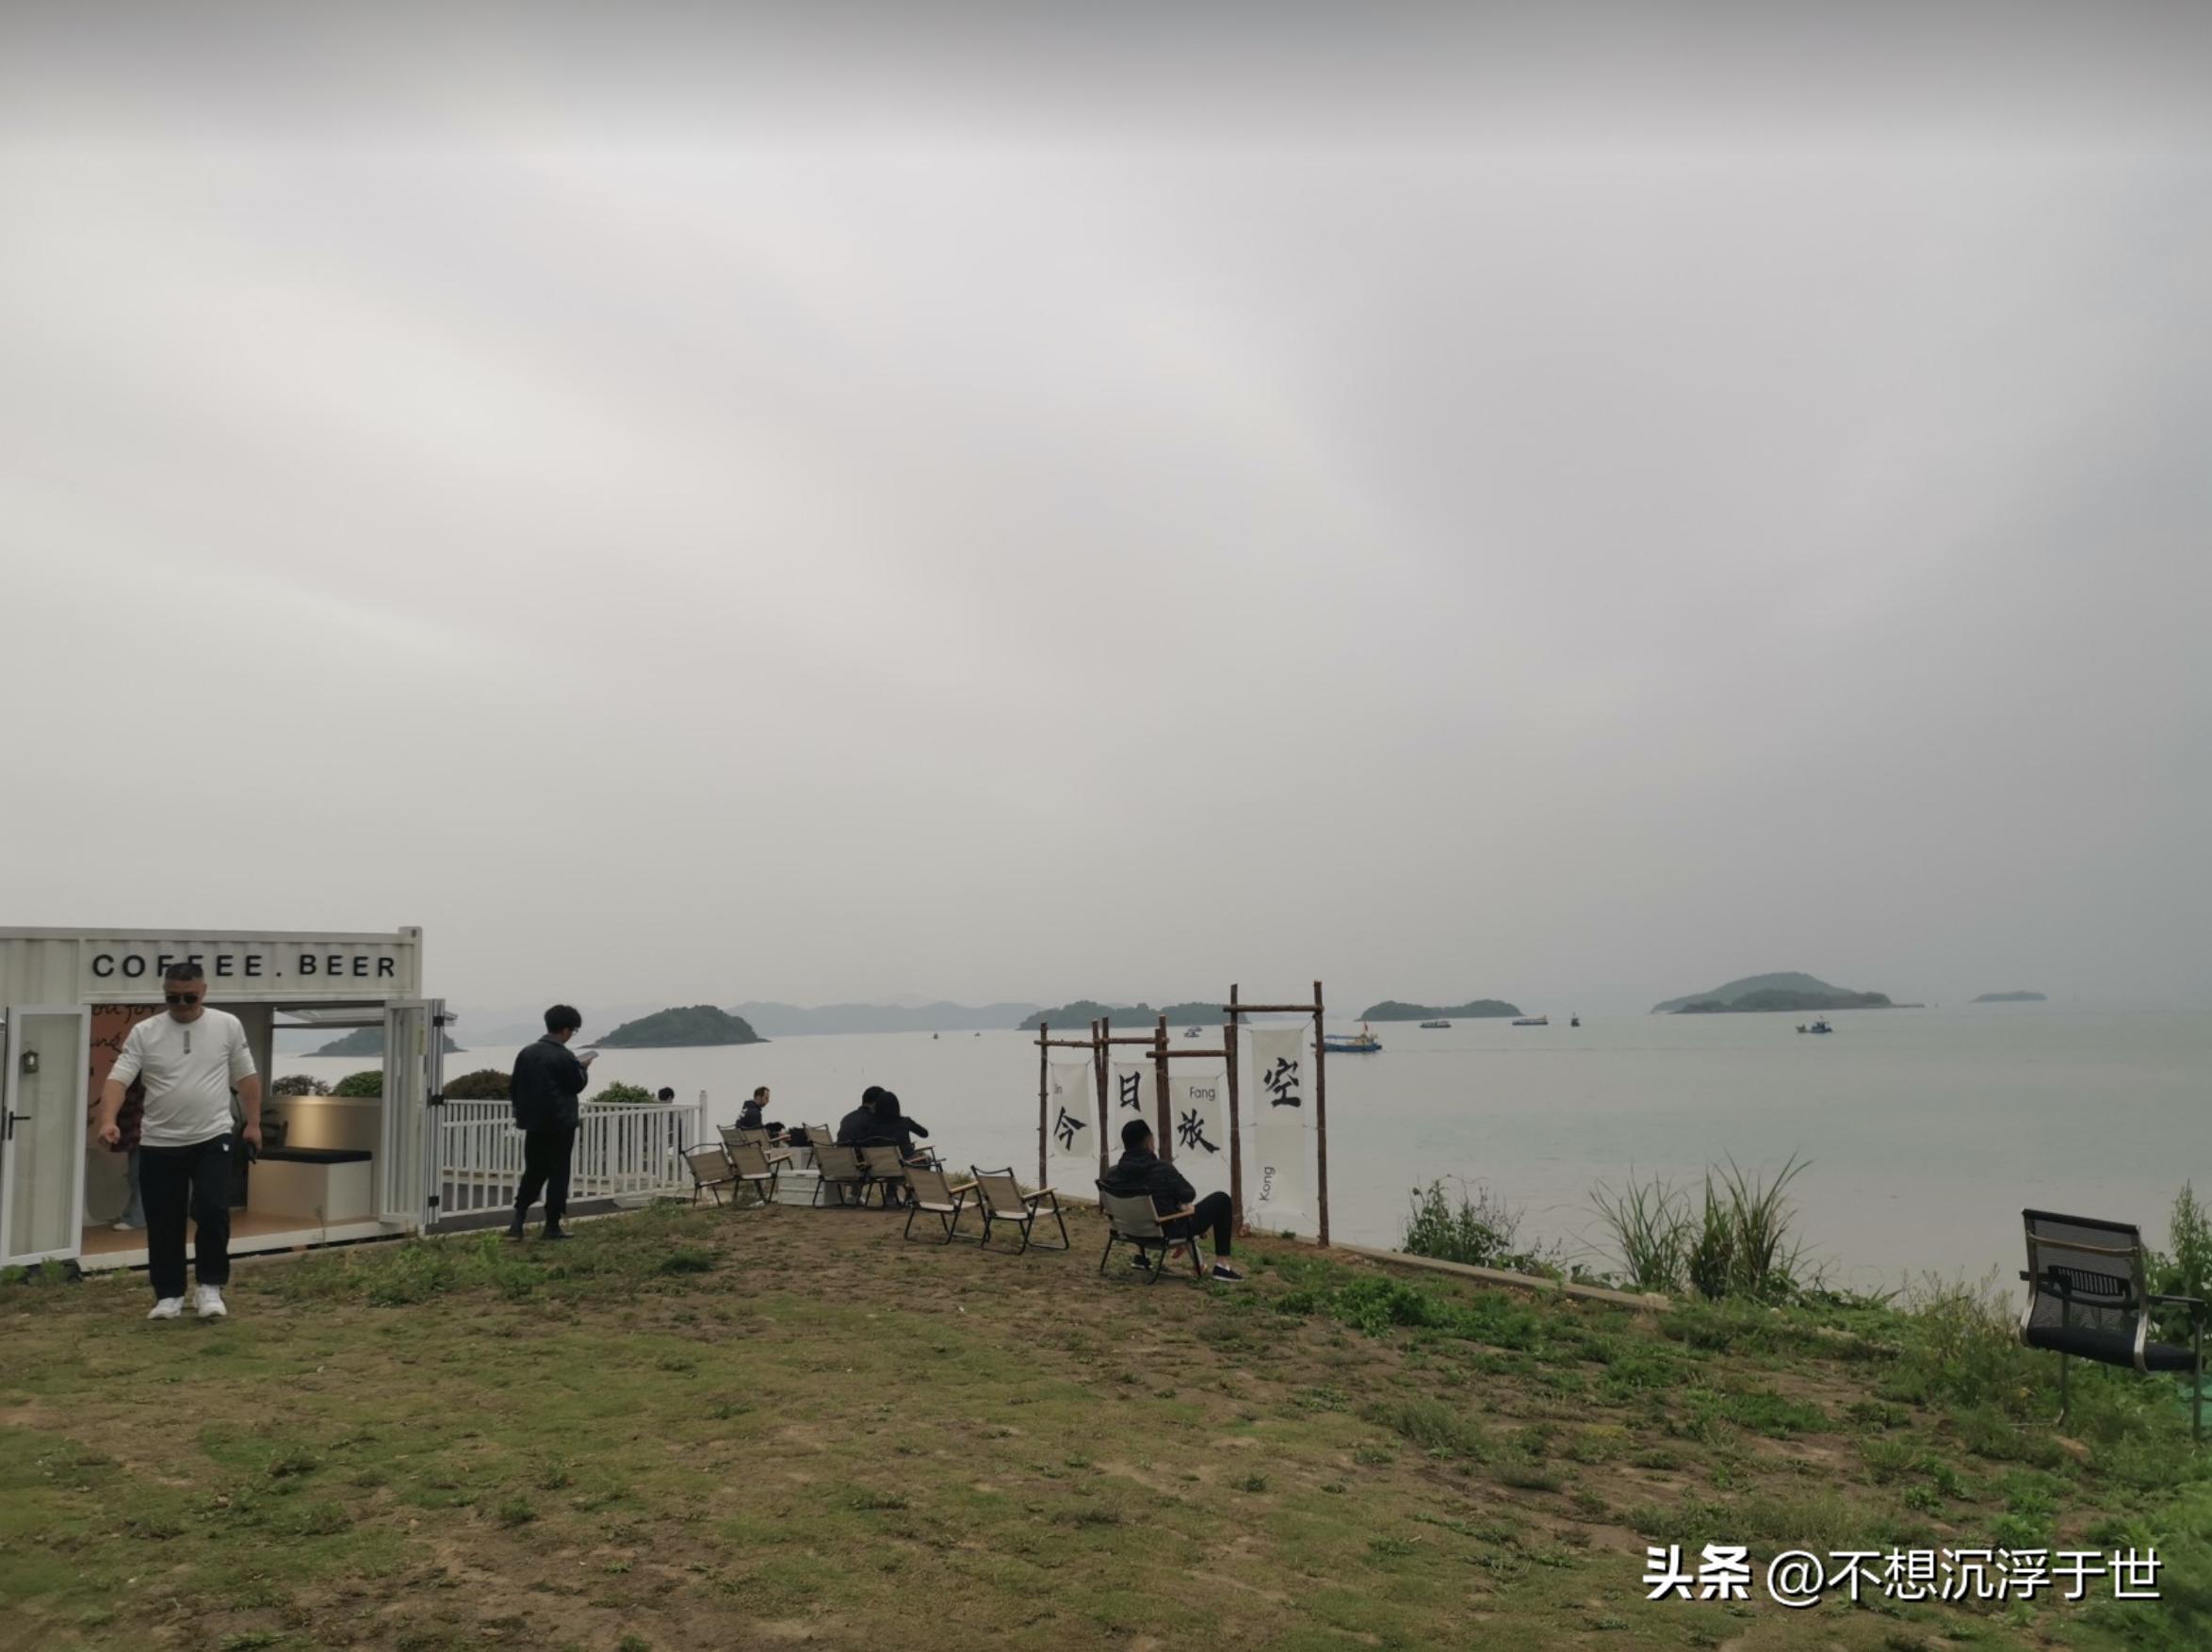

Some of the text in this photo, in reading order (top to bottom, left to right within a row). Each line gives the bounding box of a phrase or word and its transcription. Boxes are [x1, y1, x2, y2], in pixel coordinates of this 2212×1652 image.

[1119, 1071, 1141, 1112] 日
[1190, 1085, 1215, 1101] Fang
[1263, 1057, 1301, 1109] 空
[1054, 1106, 1087, 1151] 今
[1178, 1109, 1220, 1154] 放
[1259, 1166, 1276, 1202] Kong
